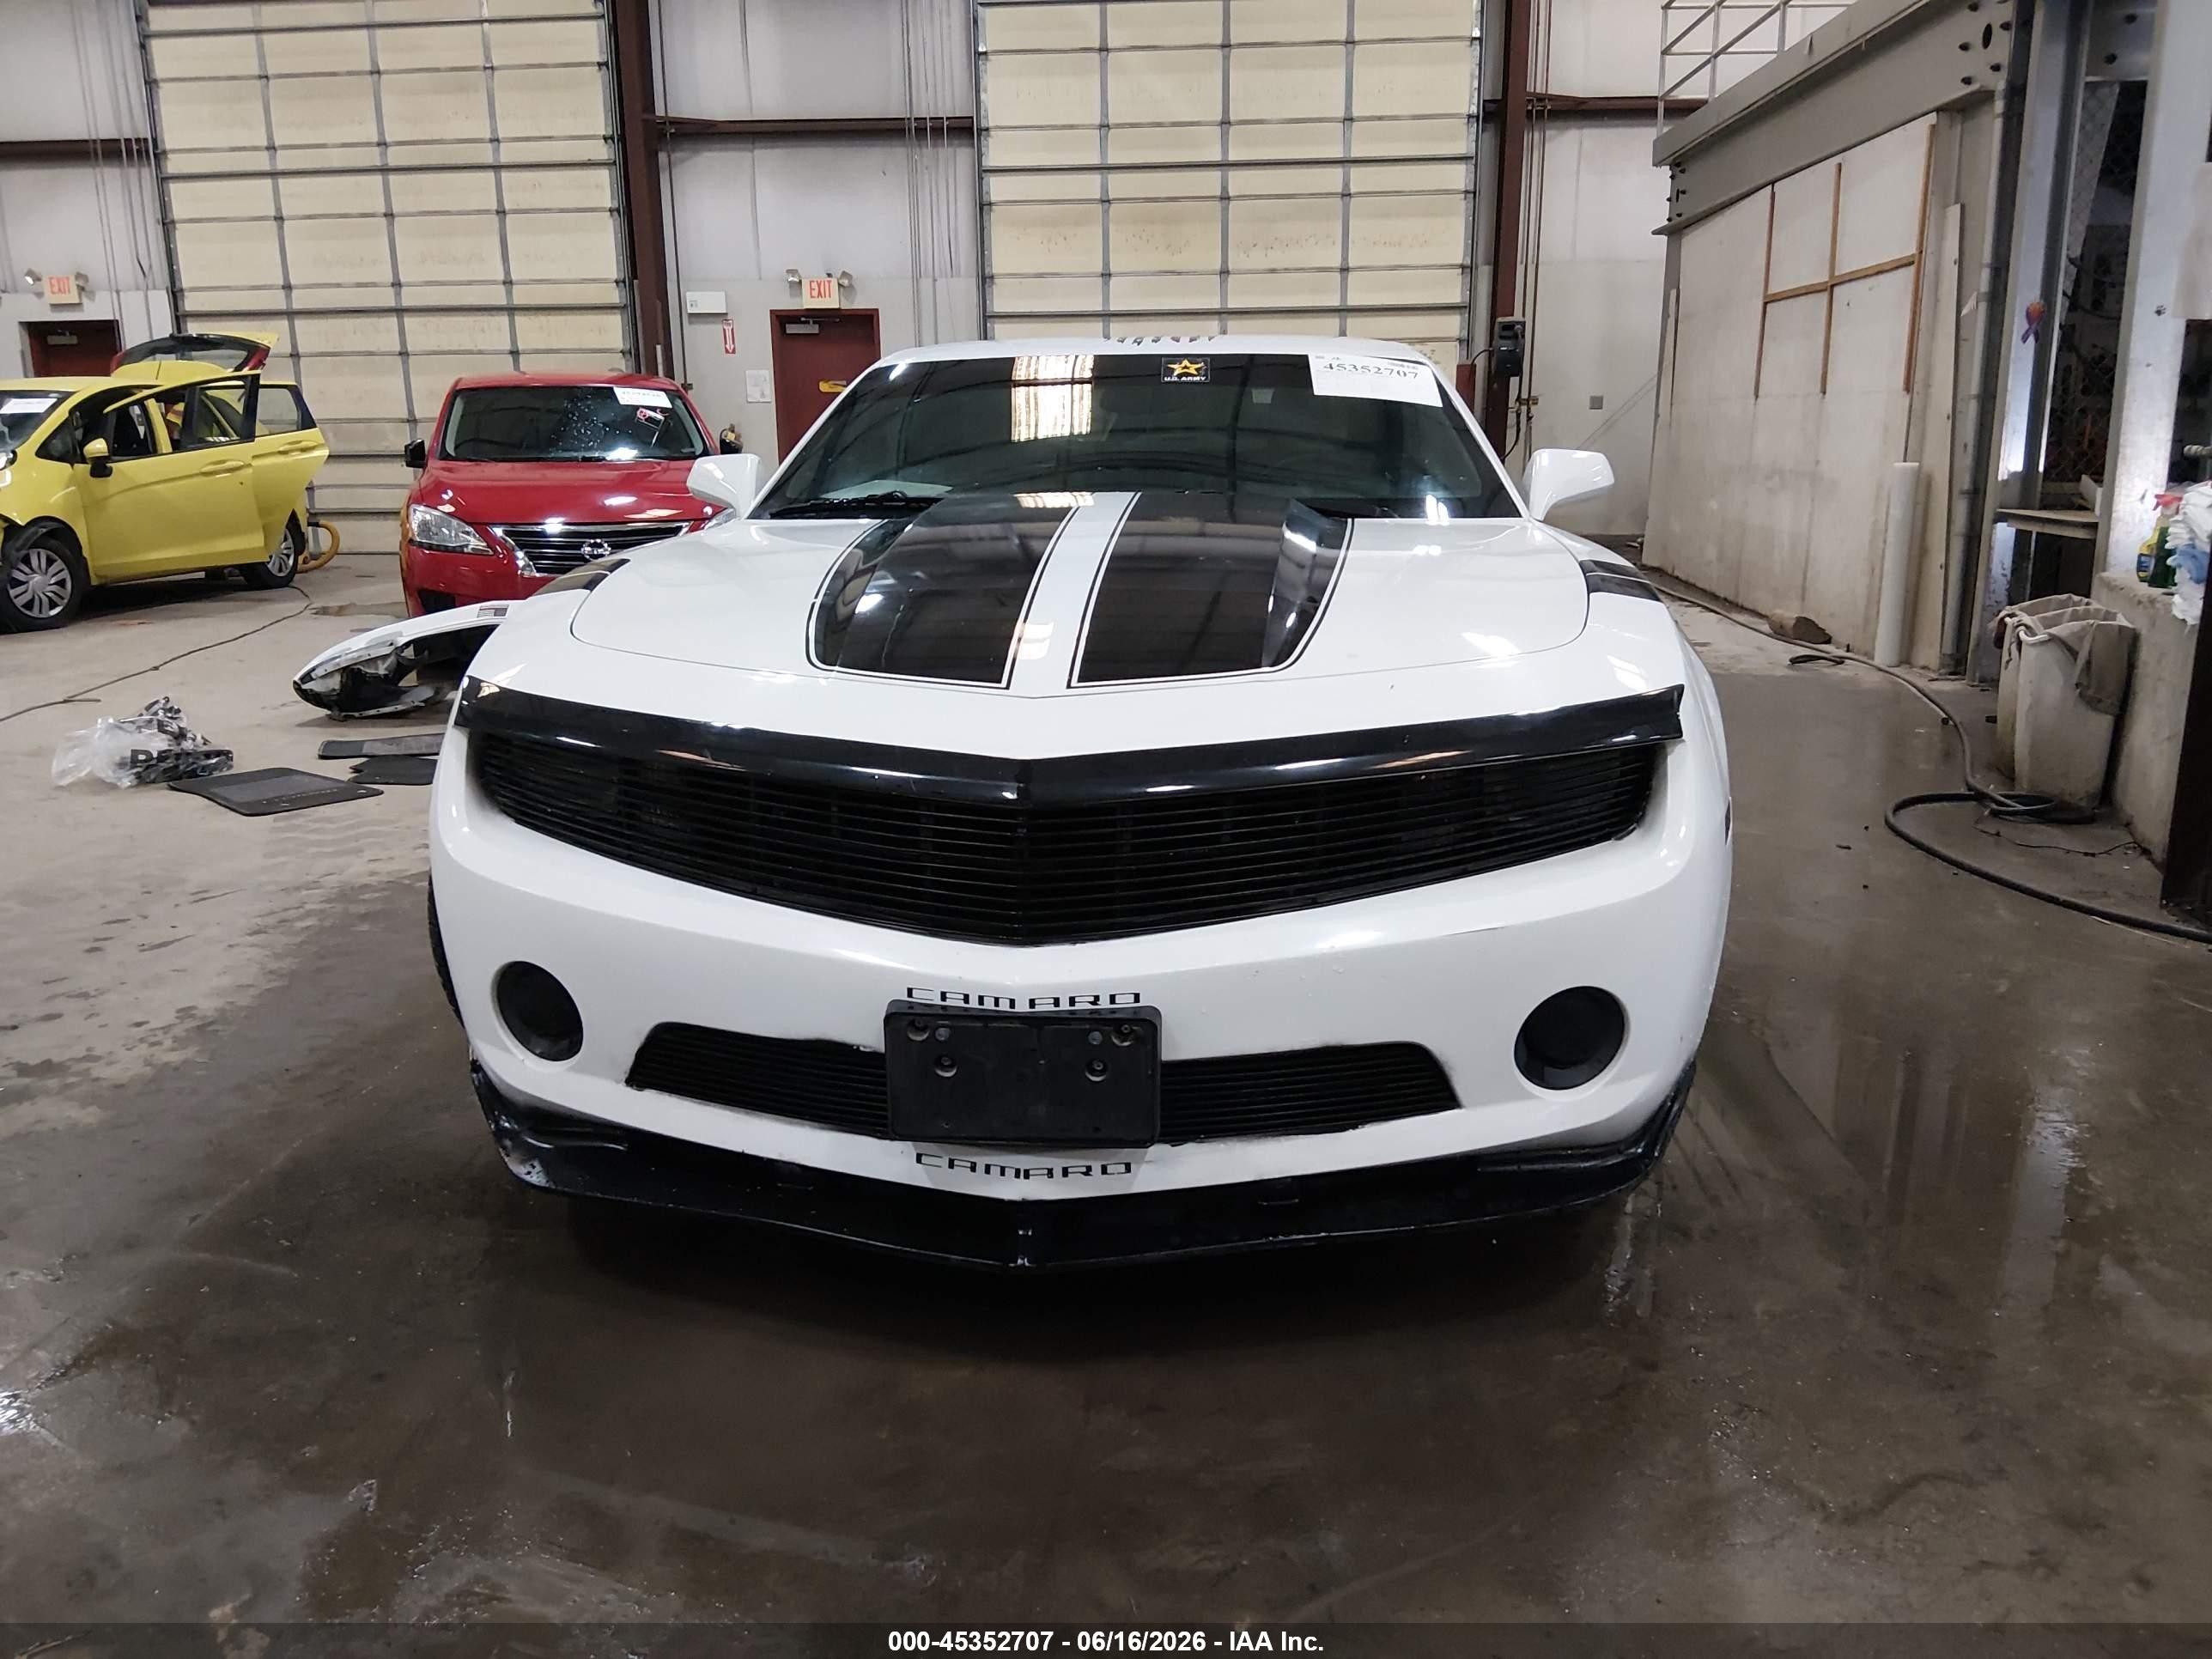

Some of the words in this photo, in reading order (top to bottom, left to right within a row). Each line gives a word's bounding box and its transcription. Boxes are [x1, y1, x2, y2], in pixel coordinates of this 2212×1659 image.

[48, 276, 70, 295] EXIT
[809, 280, 832, 299] EXIT
[1323, 362, 1419, 379] 45352707
[906, 987, 1140, 1010] CAMARO
[915, 1152, 1132, 1180] CAMARO
